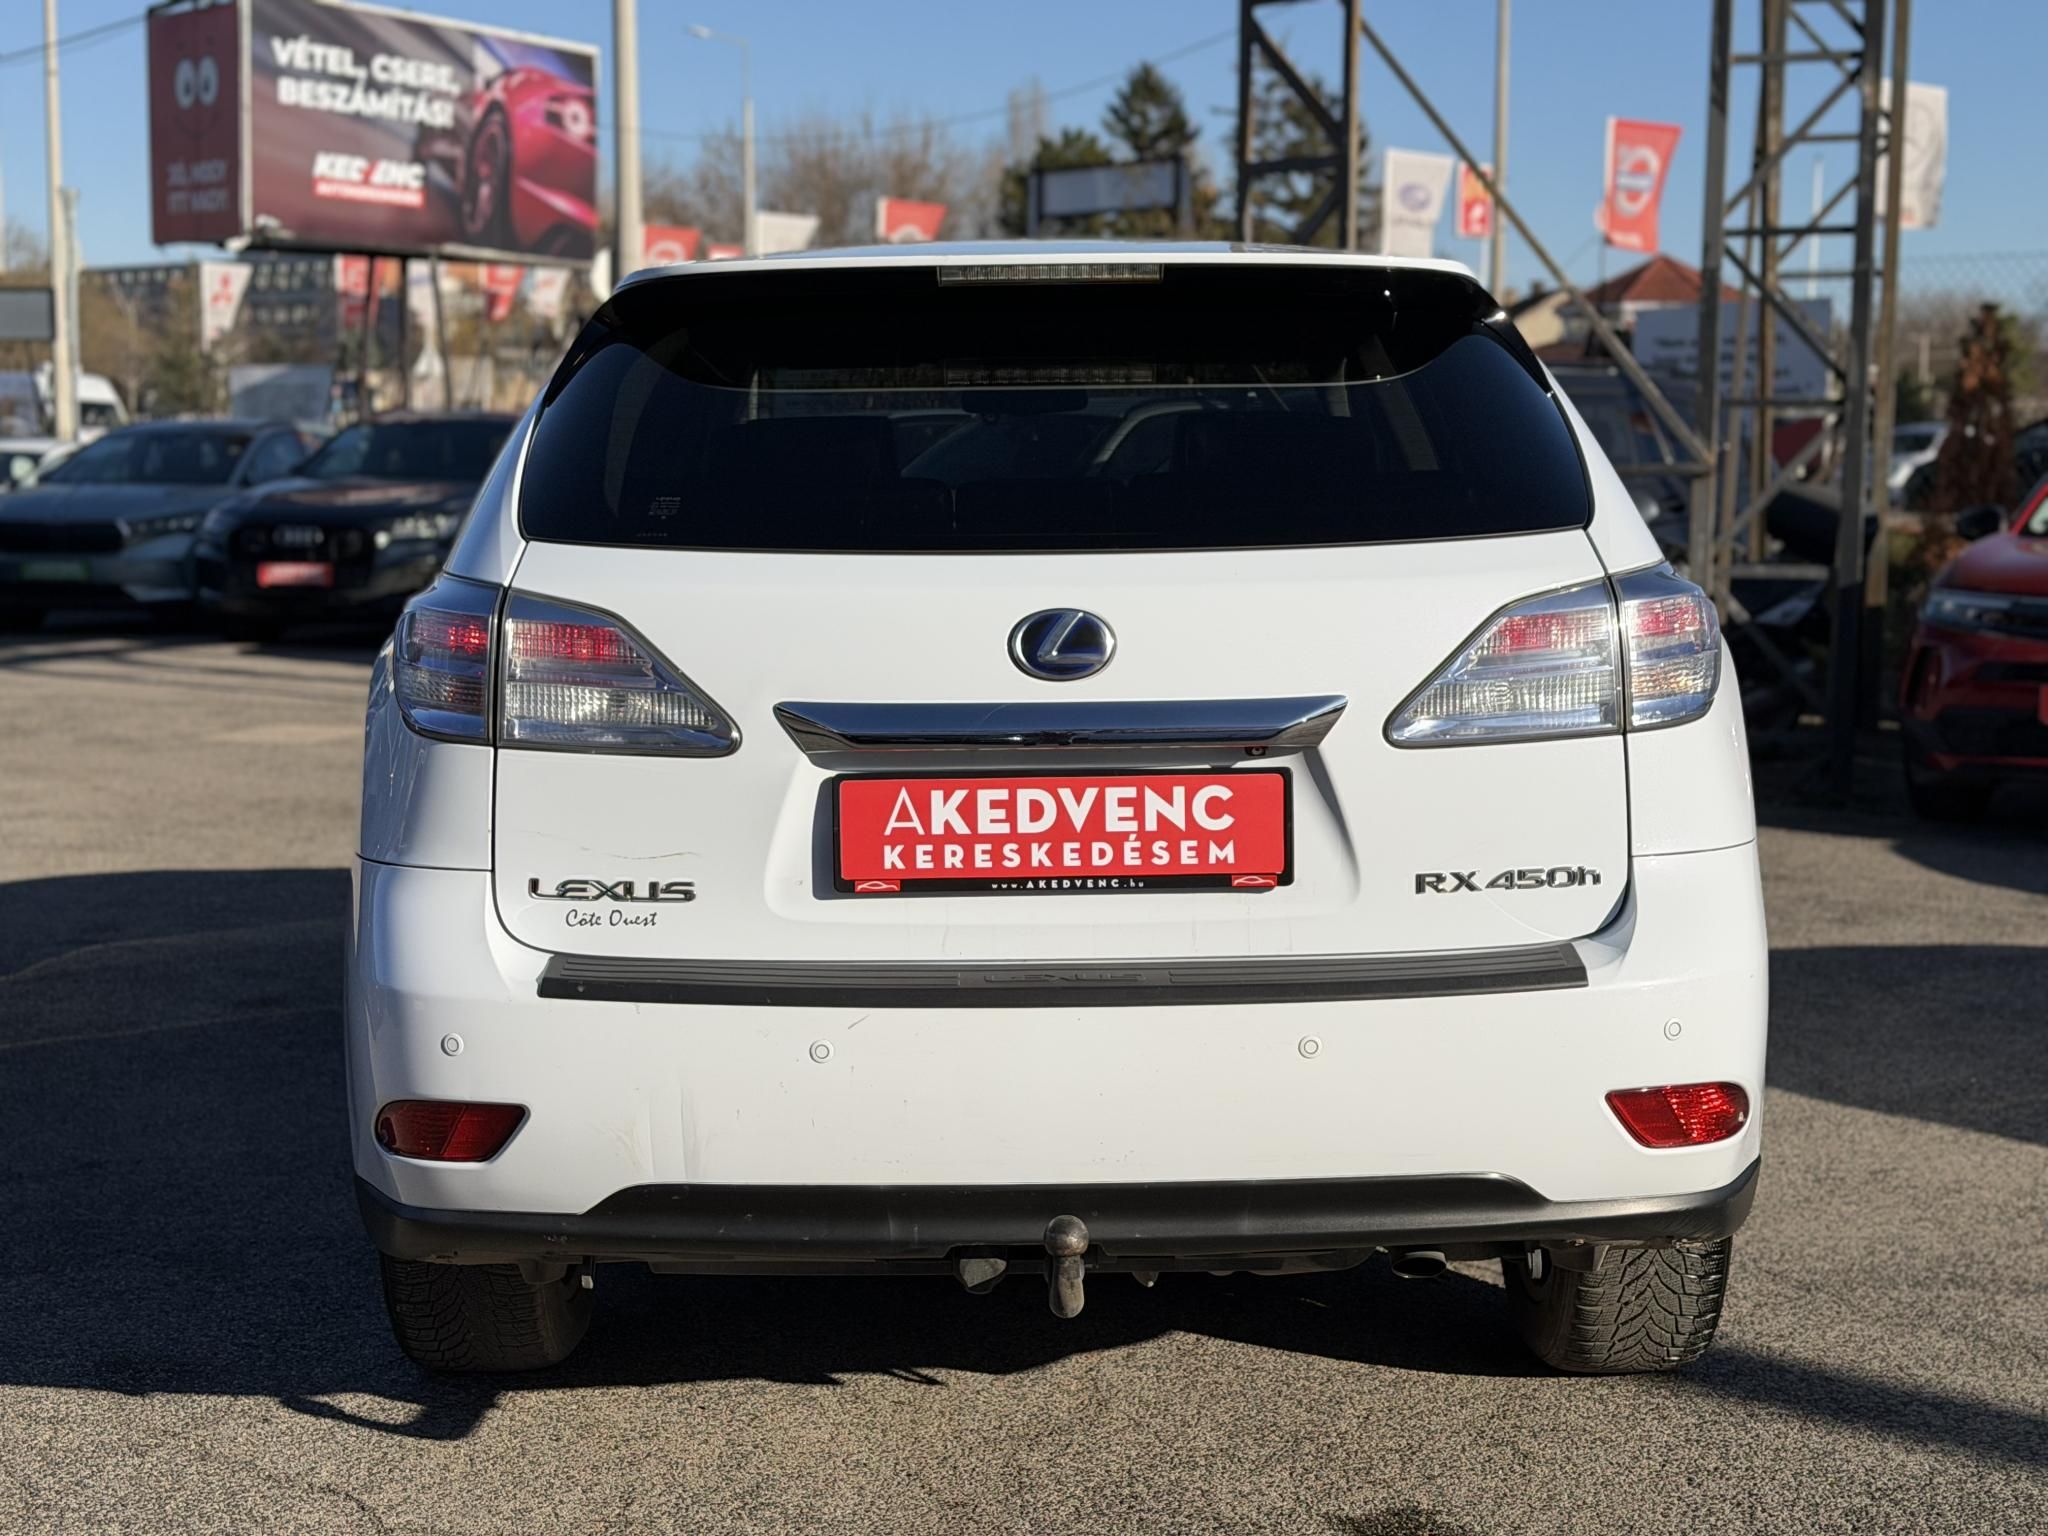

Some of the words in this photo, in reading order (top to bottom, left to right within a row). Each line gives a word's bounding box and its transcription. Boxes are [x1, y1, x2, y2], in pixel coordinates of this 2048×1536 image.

[883, 784, 1235, 836] AKEDVENC
[883, 834, 1236, 870] KERESKEDÉSEM
[528, 877, 696, 902] LEXUS
[991, 878, 1145, 889] www.AKEDVENC.hu
[1415, 869, 1483, 894] RX
[1484, 866, 1602, 890] 450h
[565, 908, 602, 927] Côte
[609, 909, 658, 927] Ouest
